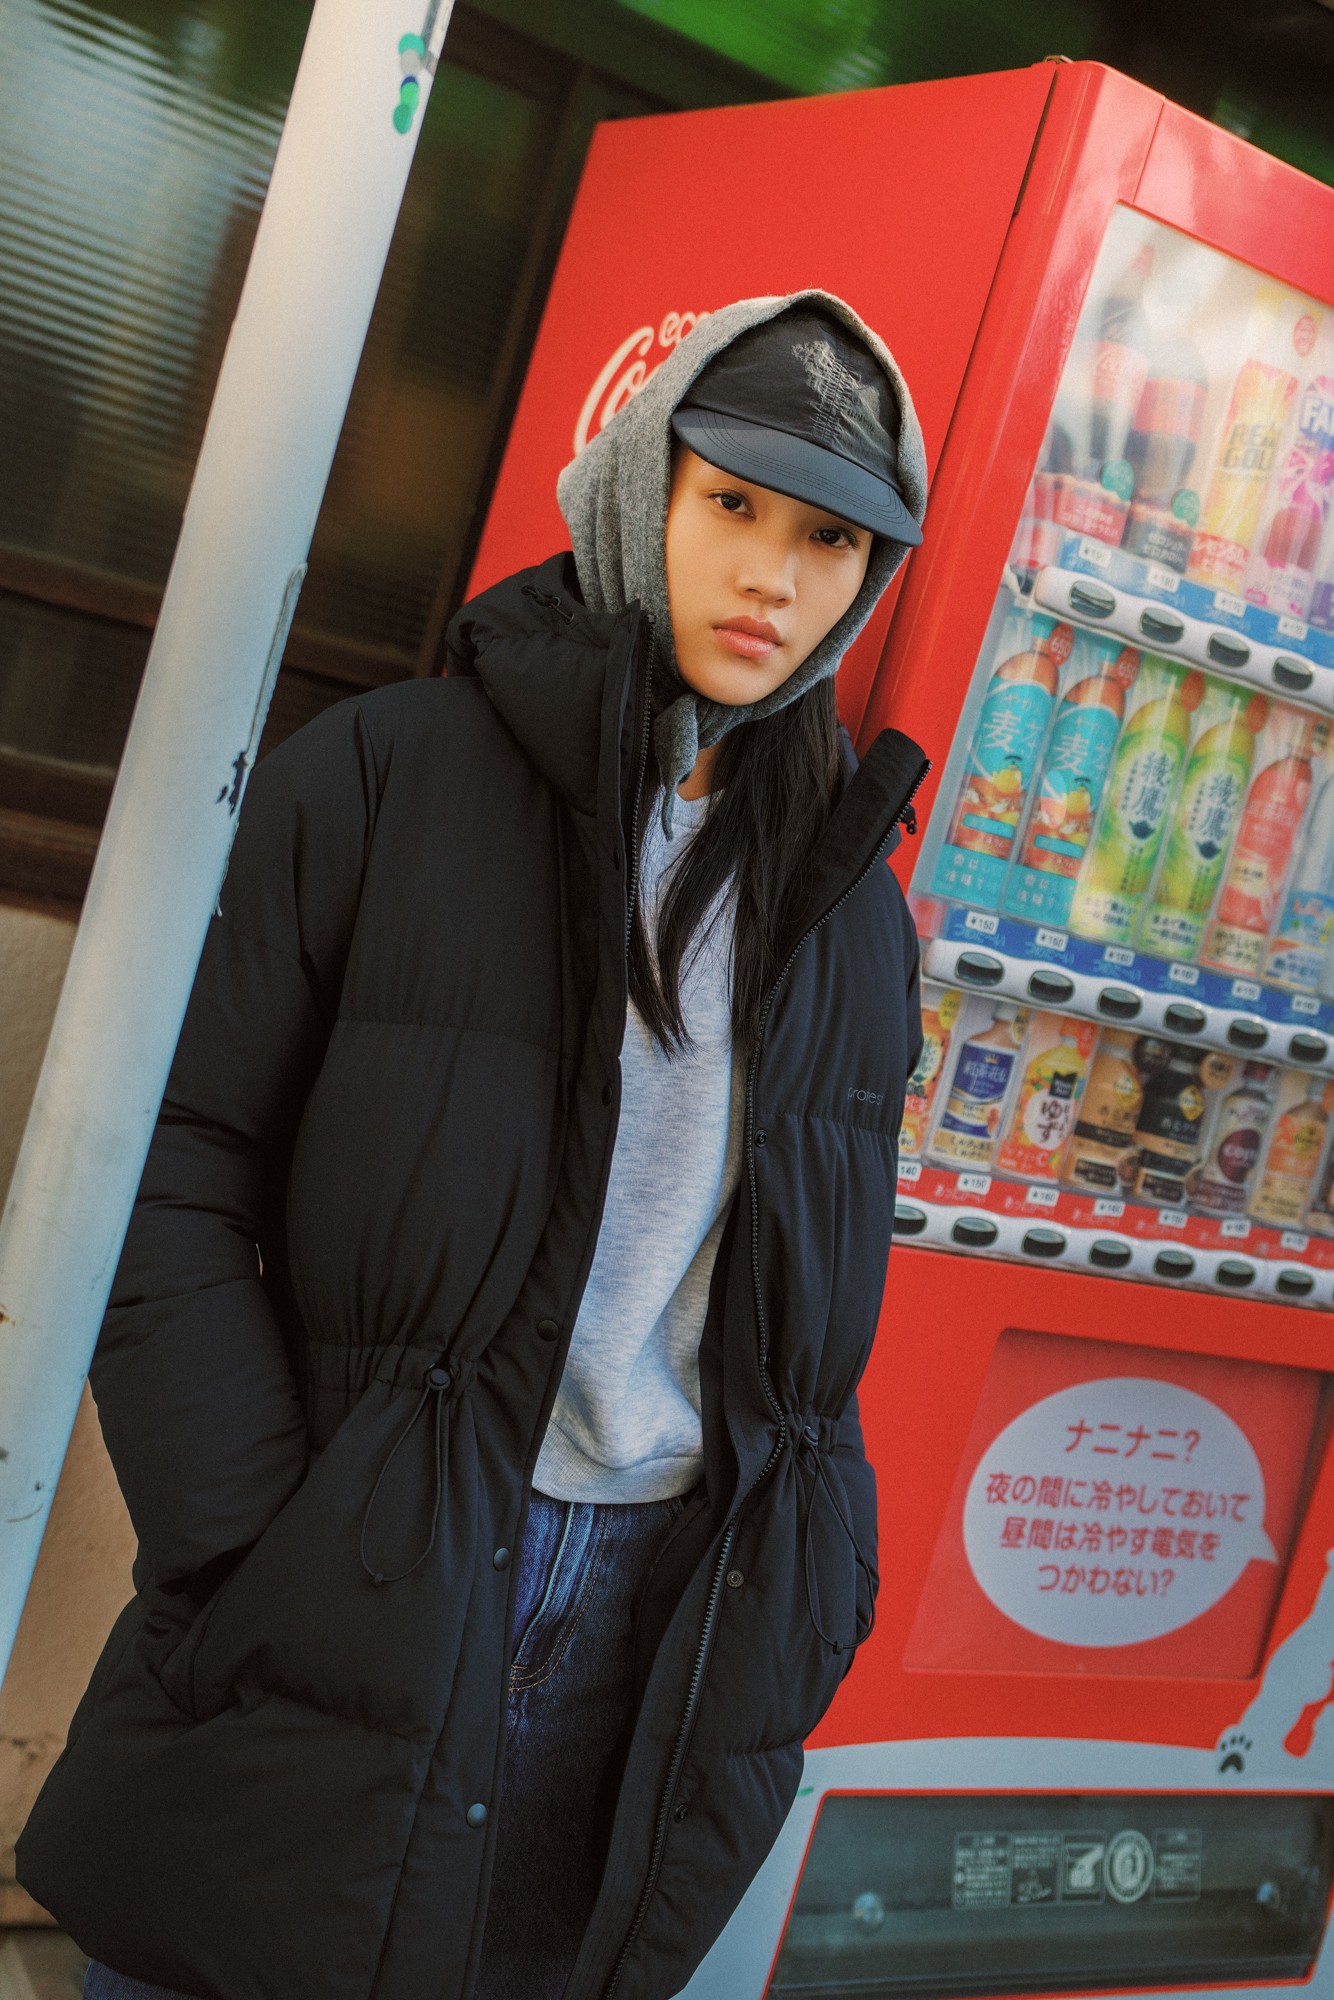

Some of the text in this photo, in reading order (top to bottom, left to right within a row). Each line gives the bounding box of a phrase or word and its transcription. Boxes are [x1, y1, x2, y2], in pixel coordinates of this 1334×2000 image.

[1049, 637, 1072, 657] 650
[1117, 660, 1138, 678] 650
[1037, 1099, 1063, 1144] ゆず
[1065, 1418, 1202, 1463] ナニナニ?
[985, 1472, 1251, 1522] 夜の間に冷やしておいて
[1001, 1516, 1221, 1562] 昼間は冷やす電気を
[1037, 1563, 1176, 1598] つかわない?
